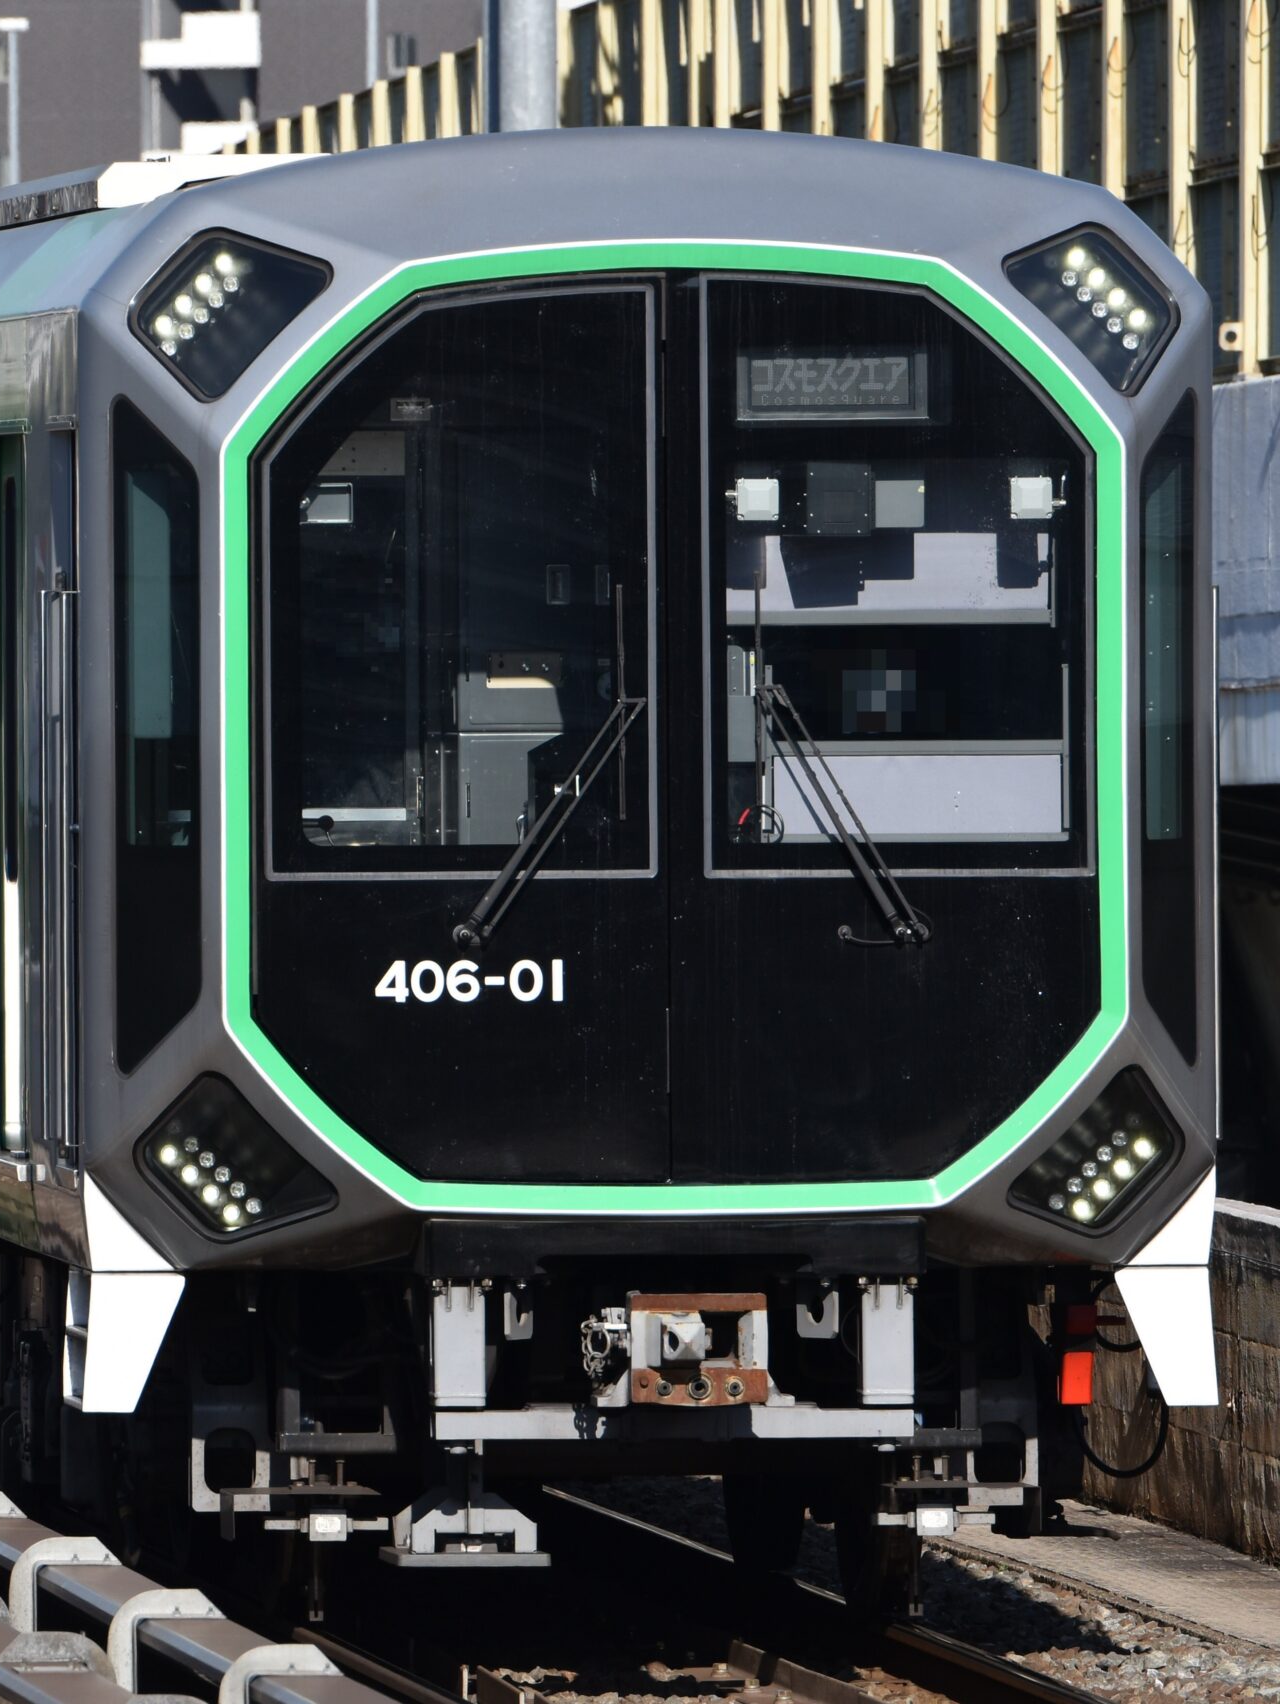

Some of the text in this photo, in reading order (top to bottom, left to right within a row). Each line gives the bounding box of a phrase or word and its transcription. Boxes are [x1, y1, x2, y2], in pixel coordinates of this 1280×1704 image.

[752, 358, 908, 392] コスモスクエア
[762, 393, 900, 405] Cosmosquare
[375, 959, 564, 1003] 406-01
